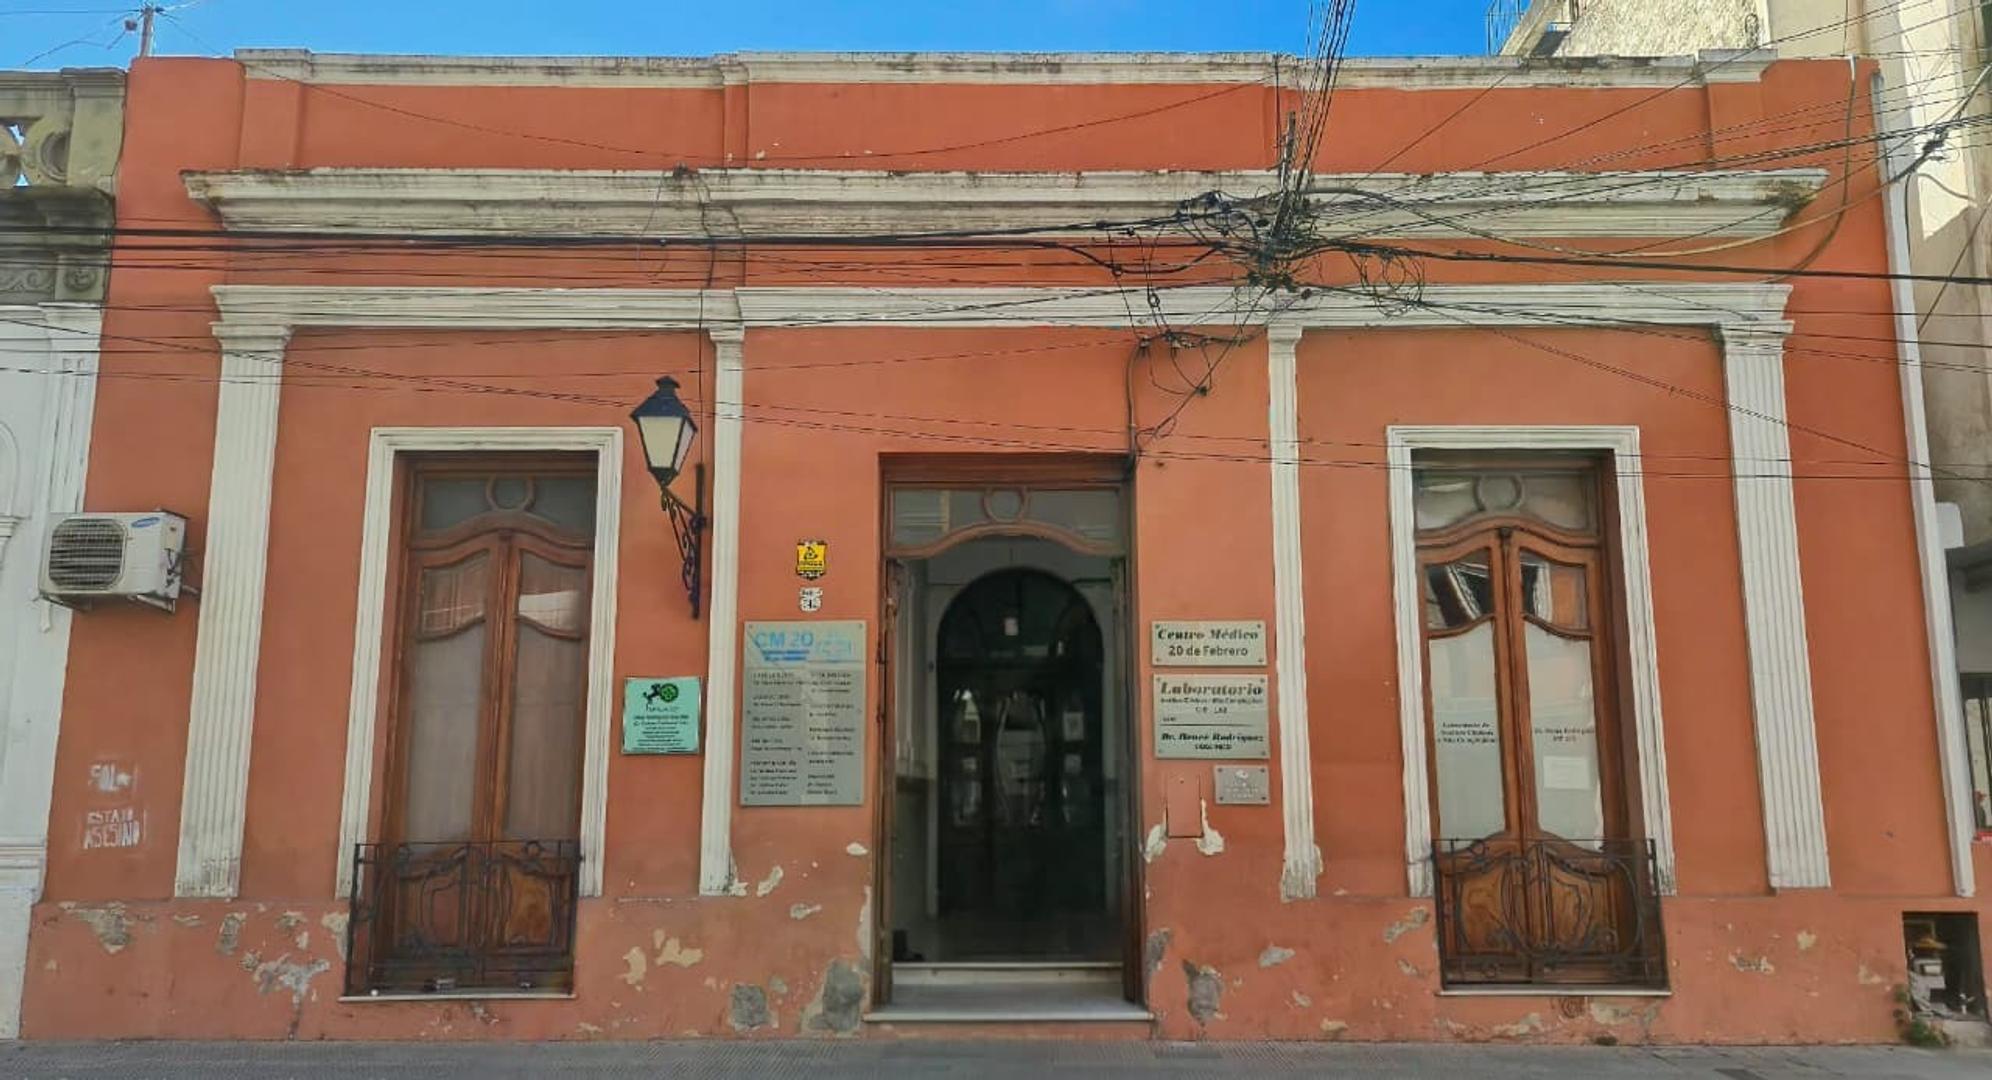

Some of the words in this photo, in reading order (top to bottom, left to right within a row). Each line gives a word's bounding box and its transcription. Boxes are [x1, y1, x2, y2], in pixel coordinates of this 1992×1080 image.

[1158, 629, 1205, 640] Centro
[1209, 629, 1258, 640] Médico
[1168, 645, 1184, 656] 20
[1186, 645, 1201, 656] de
[1203, 645, 1248, 656] Febrero
[1161, 682, 1263, 695] Laboratorio
[83, 821, 140, 849] ASESINO
